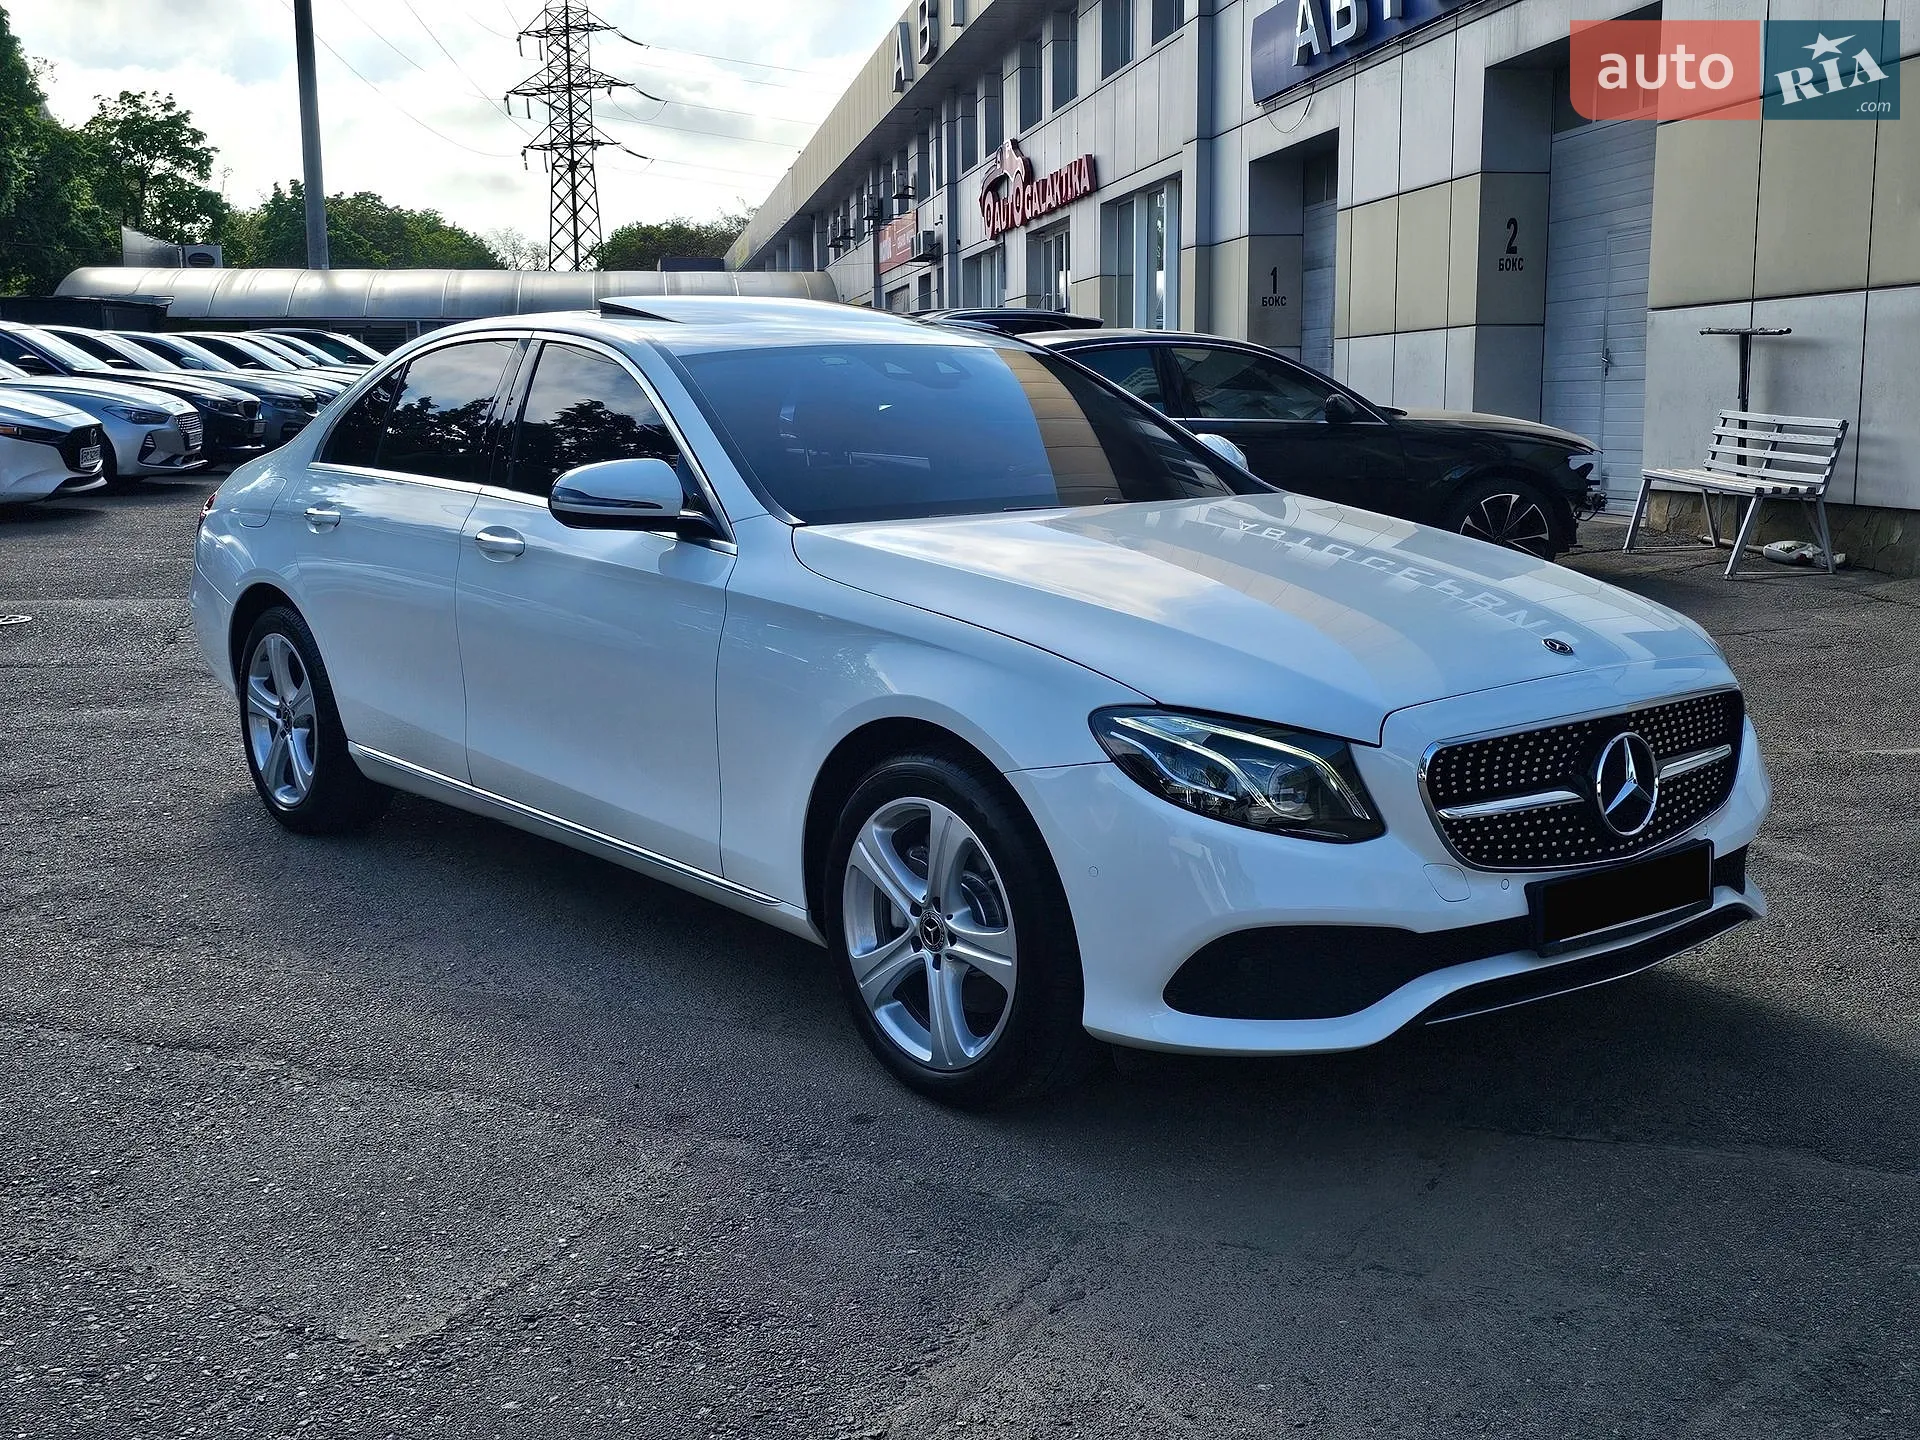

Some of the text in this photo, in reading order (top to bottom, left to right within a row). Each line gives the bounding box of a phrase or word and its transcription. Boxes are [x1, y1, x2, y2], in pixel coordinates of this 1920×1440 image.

[1505, 217, 1519, 254] 2
[1498, 257, 1524, 272] БОКС
[1270, 266, 1278, 294] 1
[1261, 296, 1287, 307] БОКС
